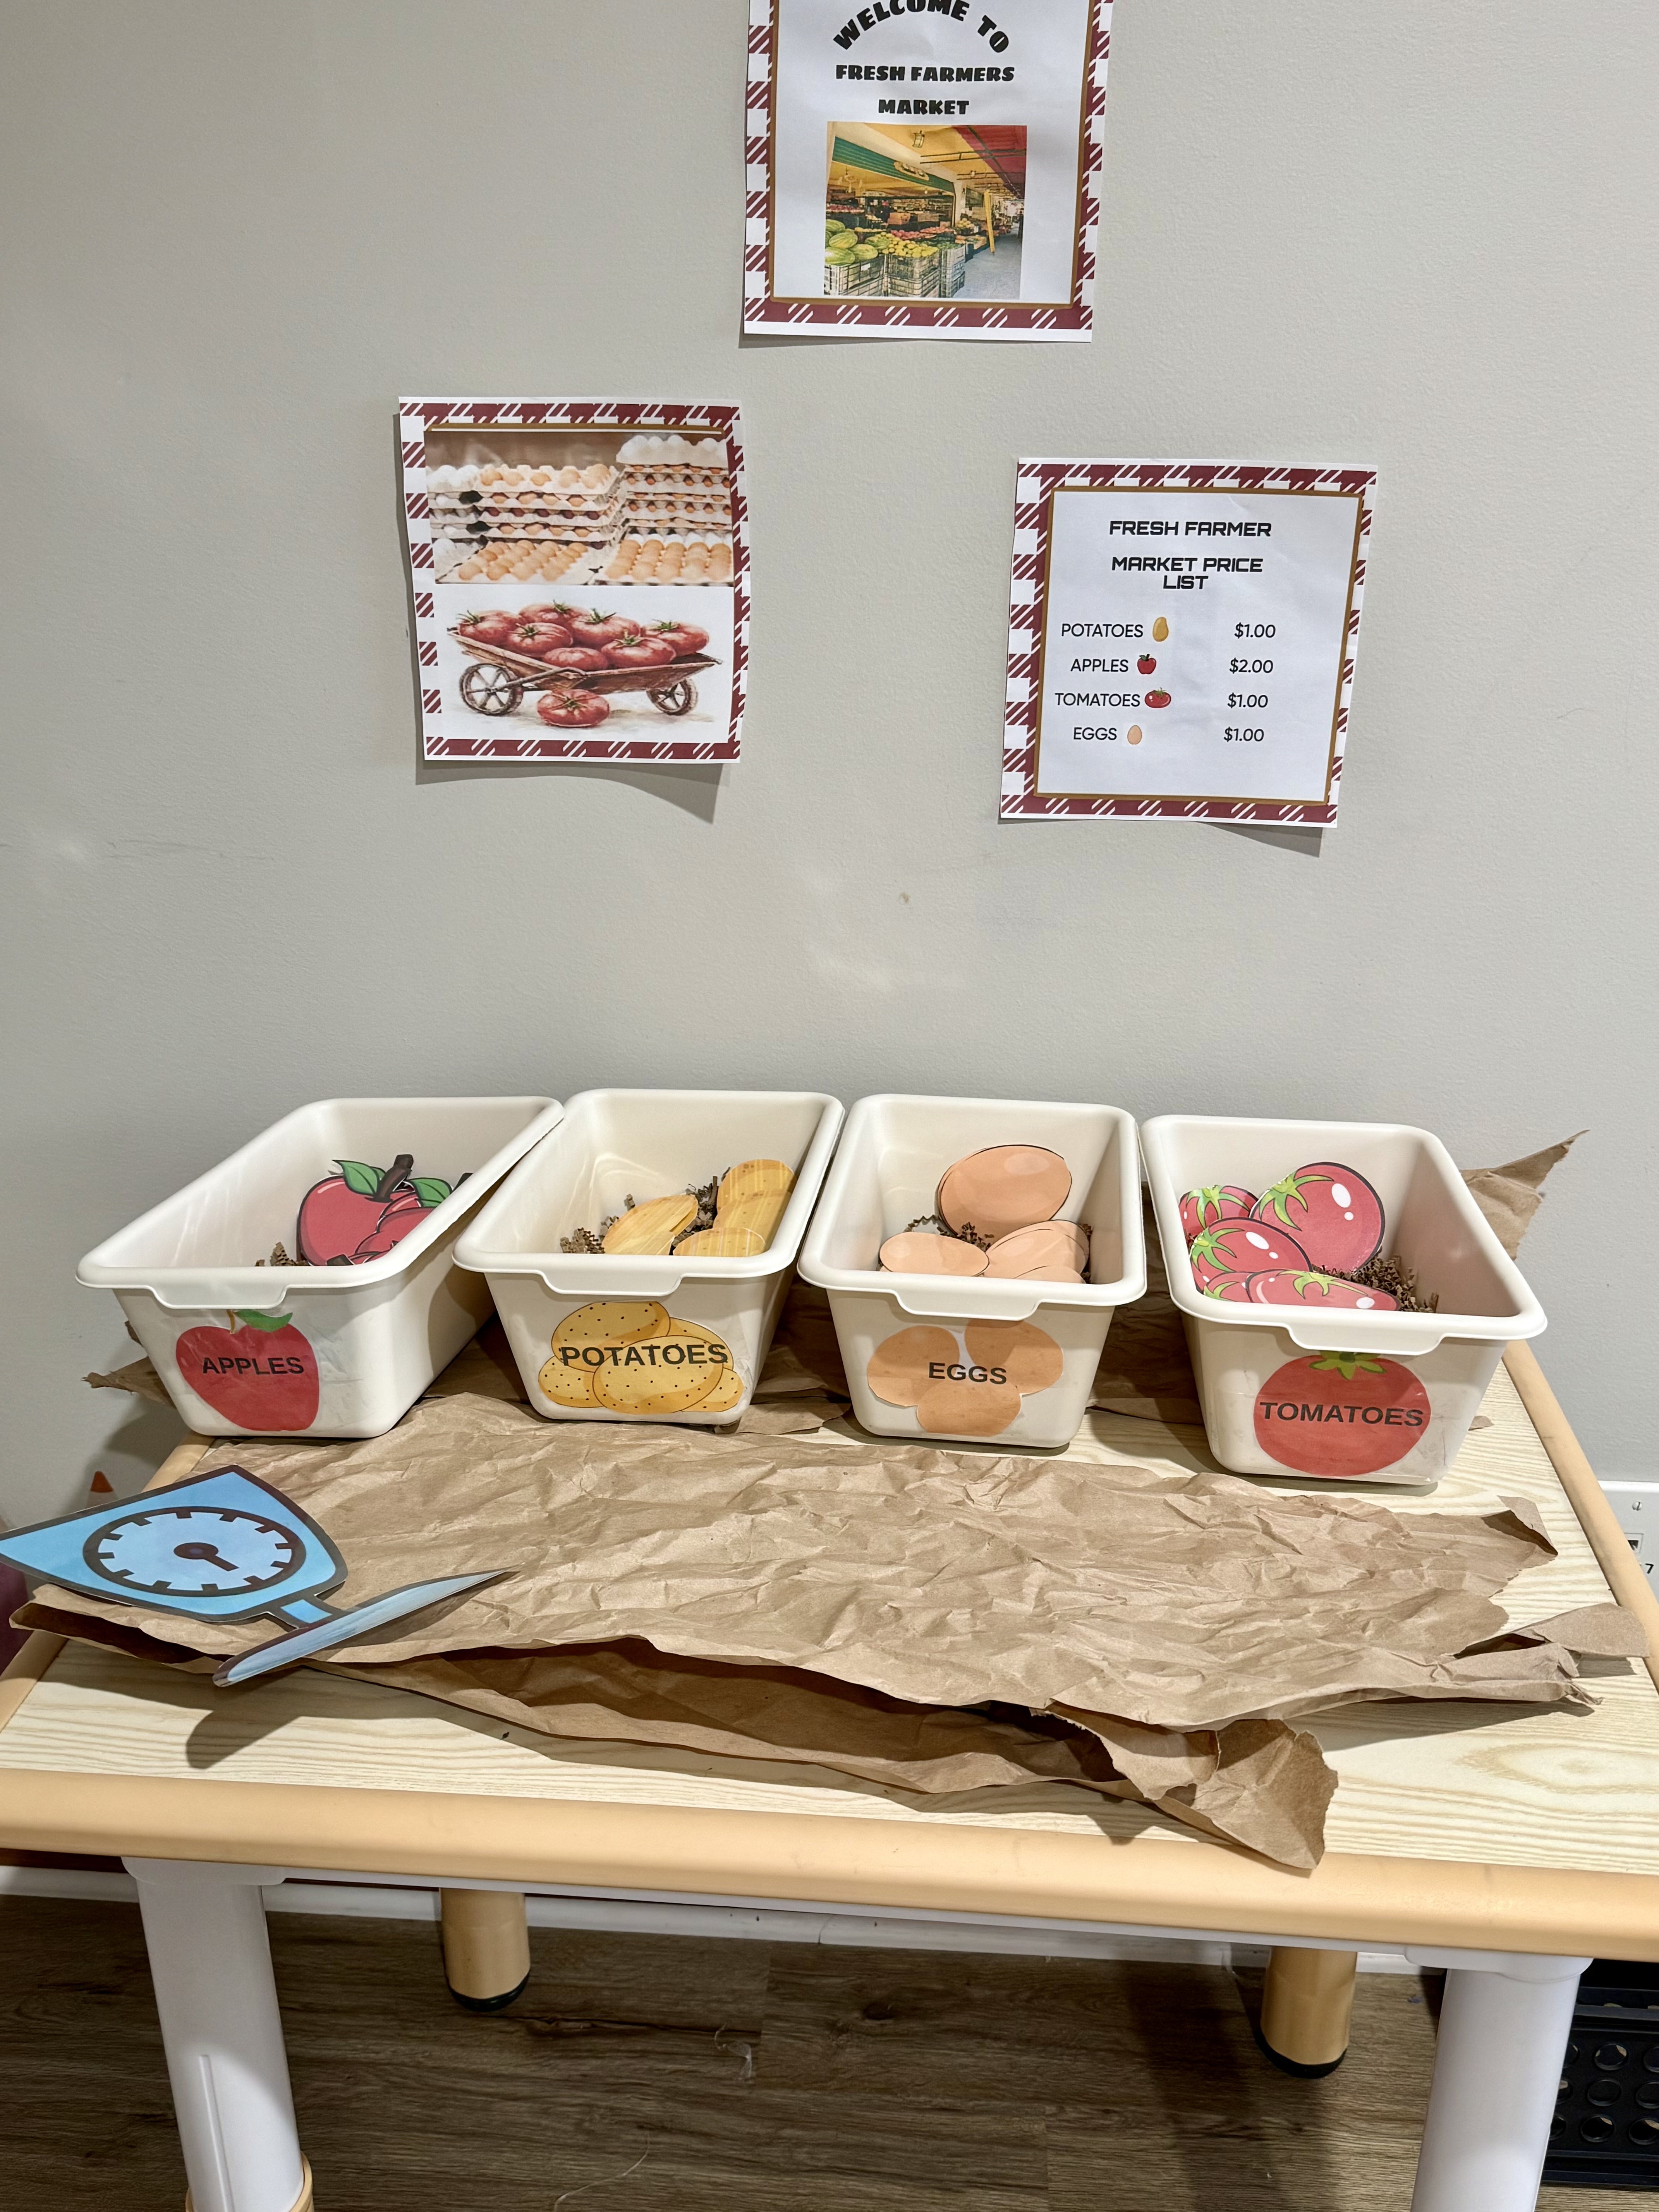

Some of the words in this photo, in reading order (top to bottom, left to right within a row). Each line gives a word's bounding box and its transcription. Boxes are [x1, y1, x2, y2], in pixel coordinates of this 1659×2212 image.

[833, 0, 970, 50] WELCOME
[977, 15, 1009, 53] TO
[836, 65, 905, 81] FRESH
[911, 67, 1015, 82] FARMERS
[878, 99, 969, 115] MARKET
[1109, 520, 1179, 536] FRESH
[1185, 521, 1272, 537] FARMER
[1112, 556, 1198, 572] MARKET
[1203, 558, 1264, 572] PRICE
[1163, 575, 1209, 589] LIST
[1061, 623, 1143, 638] POTATOES
[1234, 622, 1276, 639] $1.00
[1070, 658, 1128, 672] APPLES
[1229, 657, 1273, 674] $2.00
[1054, 693, 1140, 707] TOMATOES
[1227, 692, 1268, 709] $1.00
[1073, 727, 1117, 740] EGGS
[1223, 726, 1264, 742] $1.00
[561, 1344, 728, 1366] POTATOES
[202, 1357, 304, 1375] APPLES
[928, 1362, 1007, 1384] EGGS
[1259, 1401, 1423, 1427] TOMATOES
